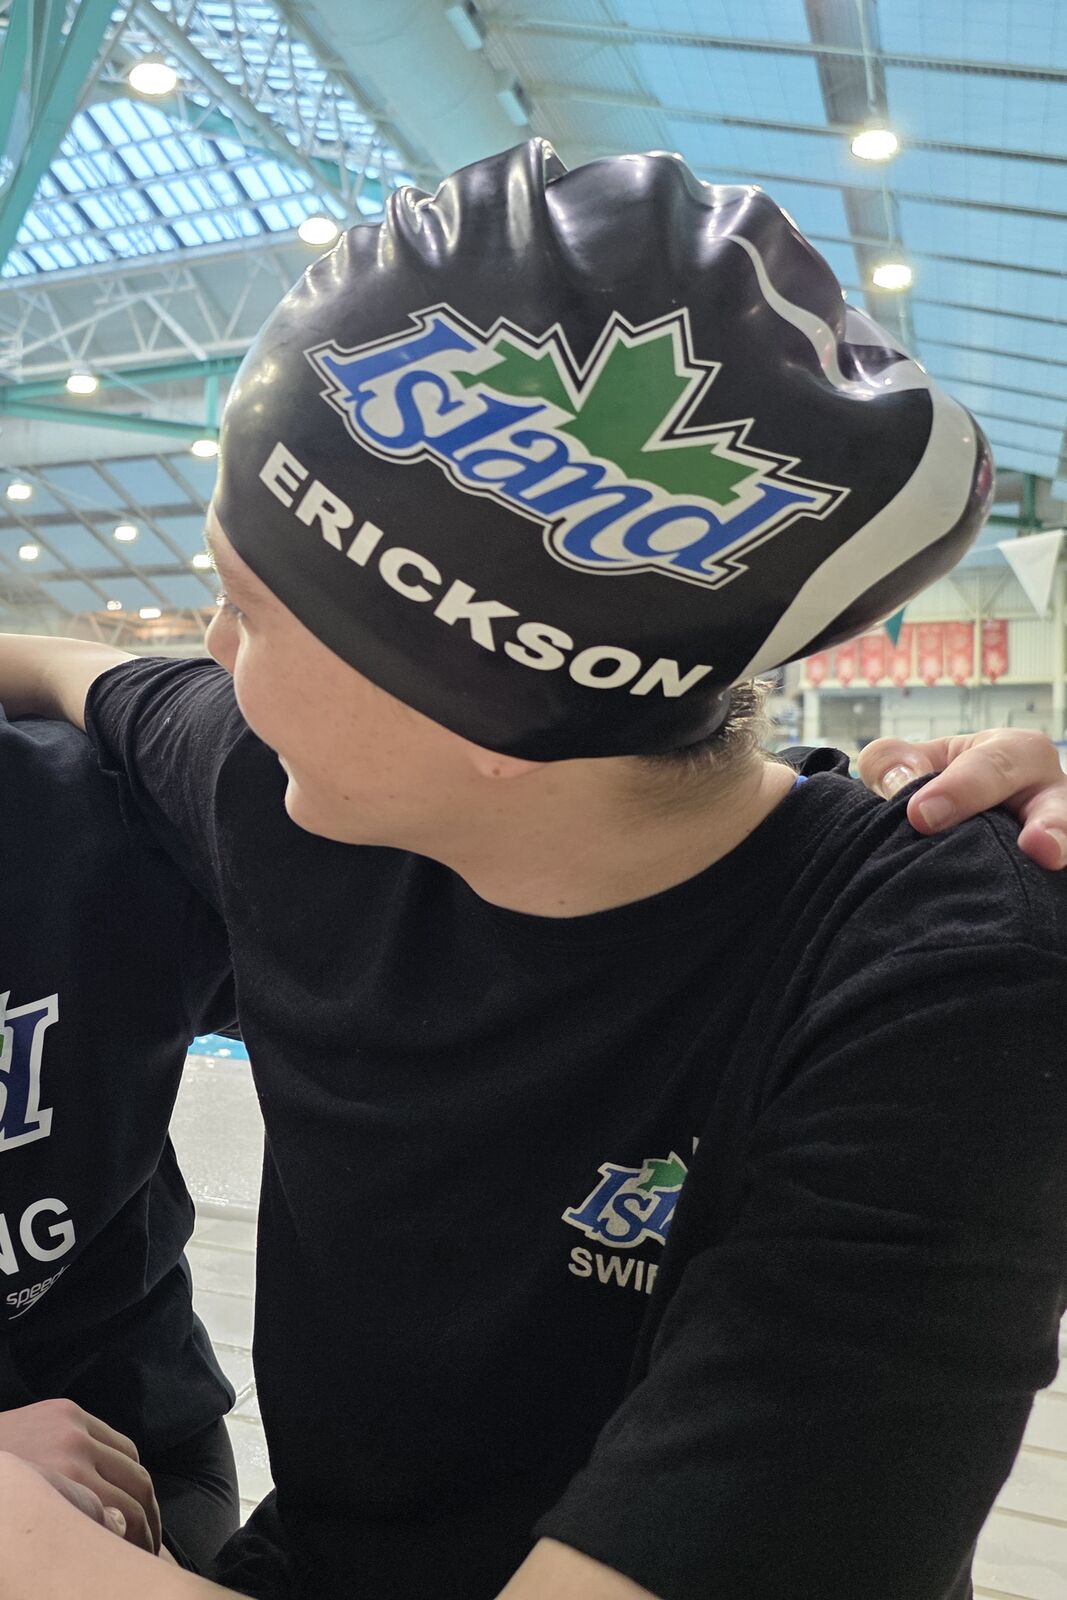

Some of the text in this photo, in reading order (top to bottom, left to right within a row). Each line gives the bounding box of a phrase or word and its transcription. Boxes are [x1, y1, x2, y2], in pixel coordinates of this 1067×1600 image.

[258, 441, 713, 698] ERICKSON
[321, 317, 819, 576] Island
[567, 1167, 683, 1242] Isl
